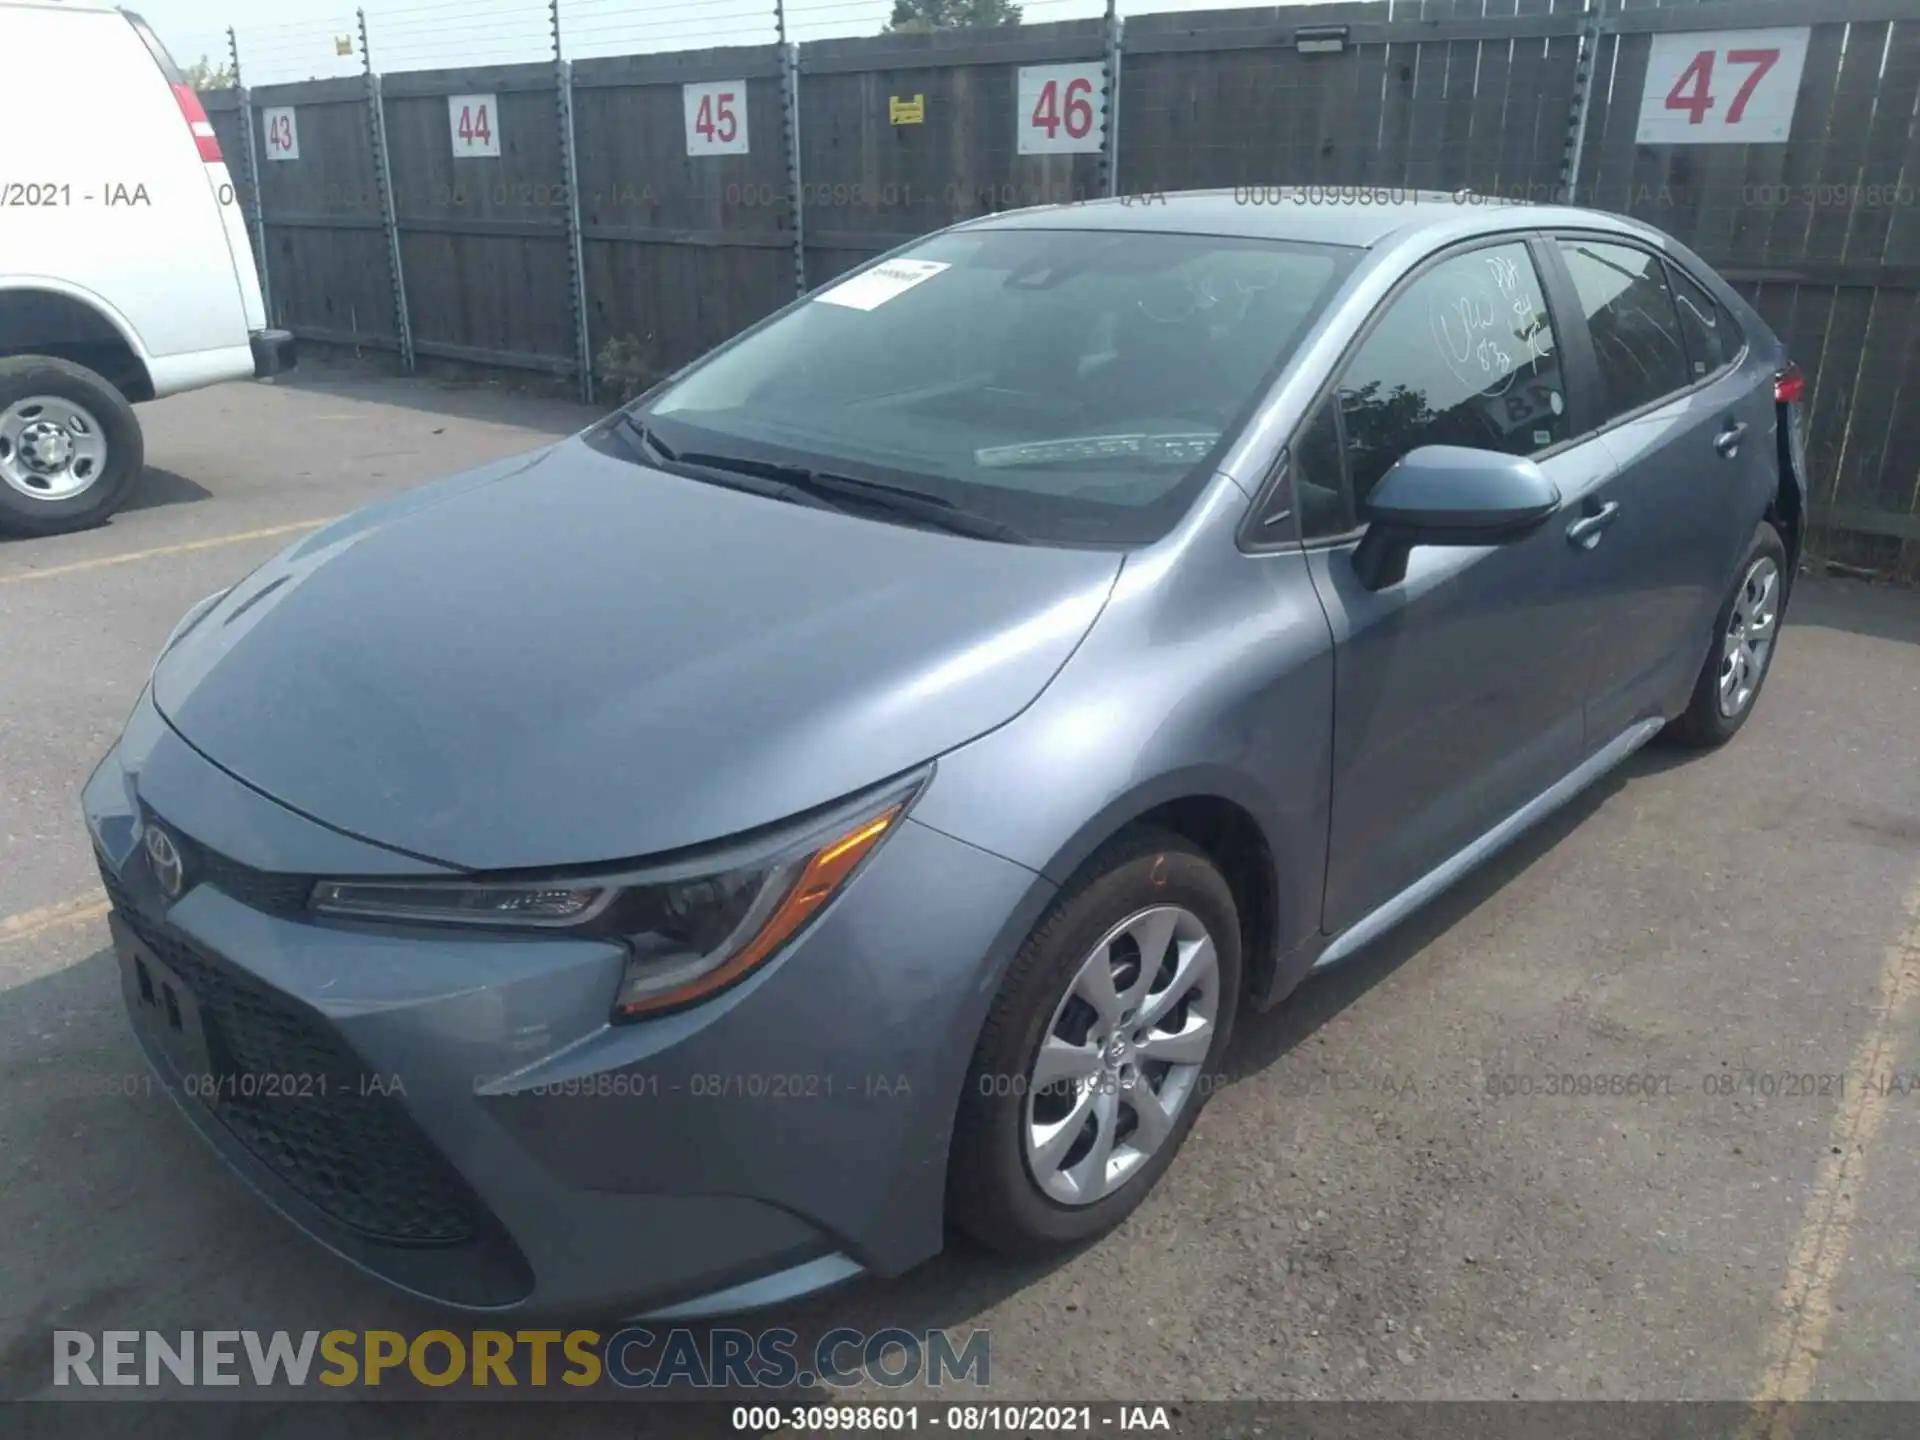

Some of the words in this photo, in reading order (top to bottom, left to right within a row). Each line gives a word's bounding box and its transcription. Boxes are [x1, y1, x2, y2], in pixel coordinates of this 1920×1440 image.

[1031, 78, 1094, 140] 46
[1665, 48, 1781, 125] 47
[270, 115, 292, 151] 43
[459, 104, 491, 147] 44
[695, 93, 738, 144] 45
